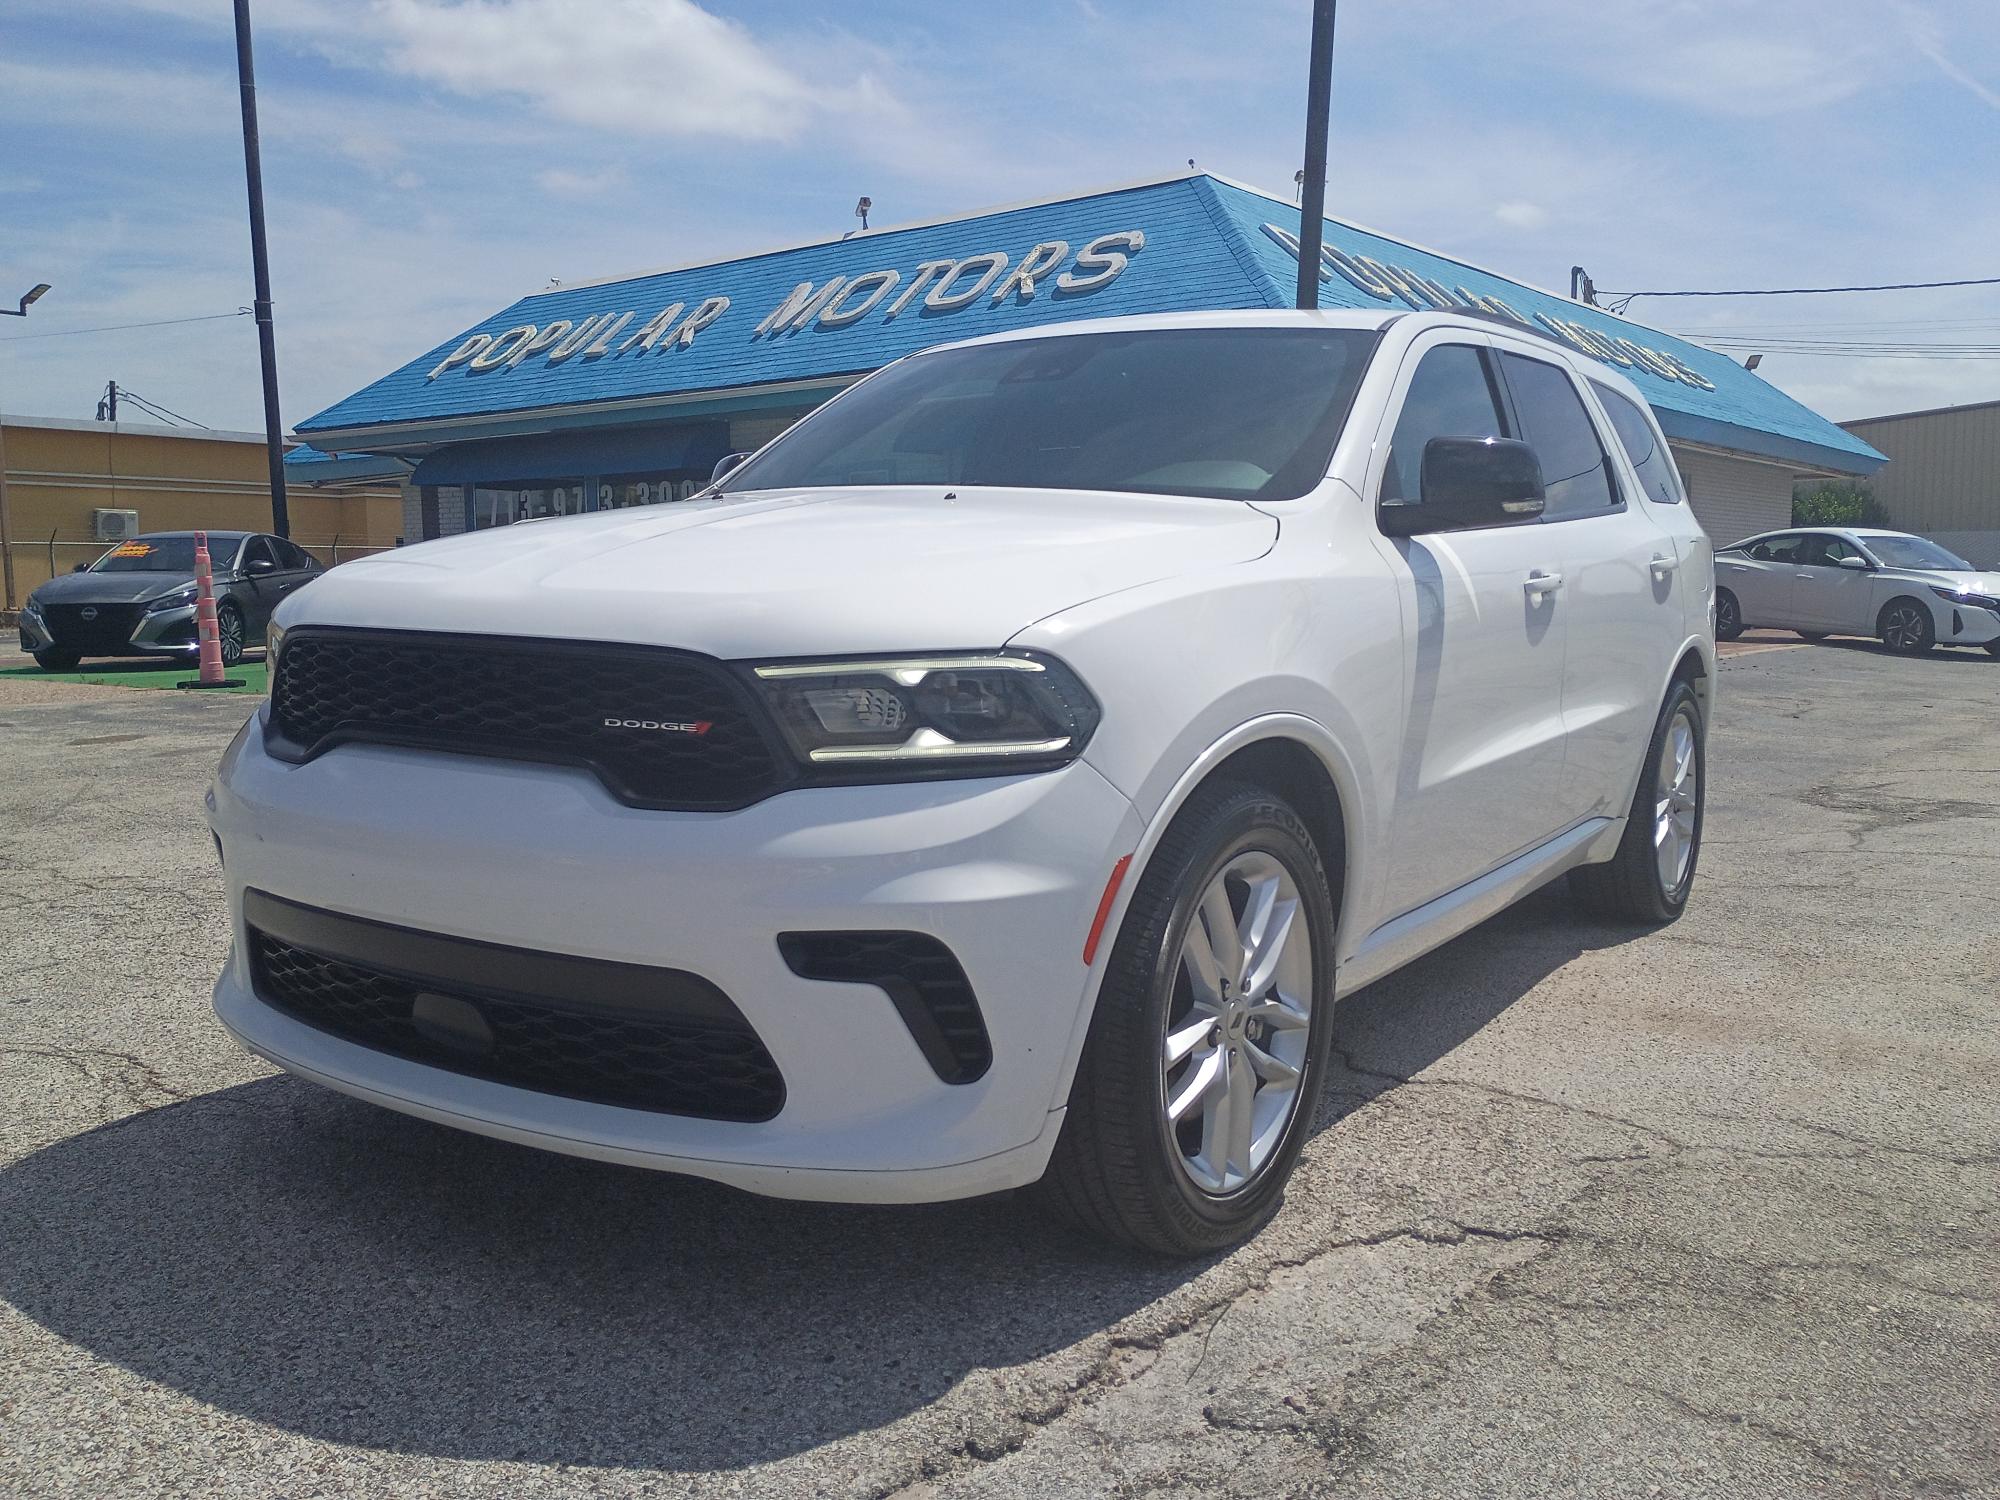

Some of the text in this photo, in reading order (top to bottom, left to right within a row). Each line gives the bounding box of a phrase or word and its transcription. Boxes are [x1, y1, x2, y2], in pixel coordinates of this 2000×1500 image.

[426, 229, 1146, 381] POPULAR MOTORS
[604, 718, 698, 733] DODGE
